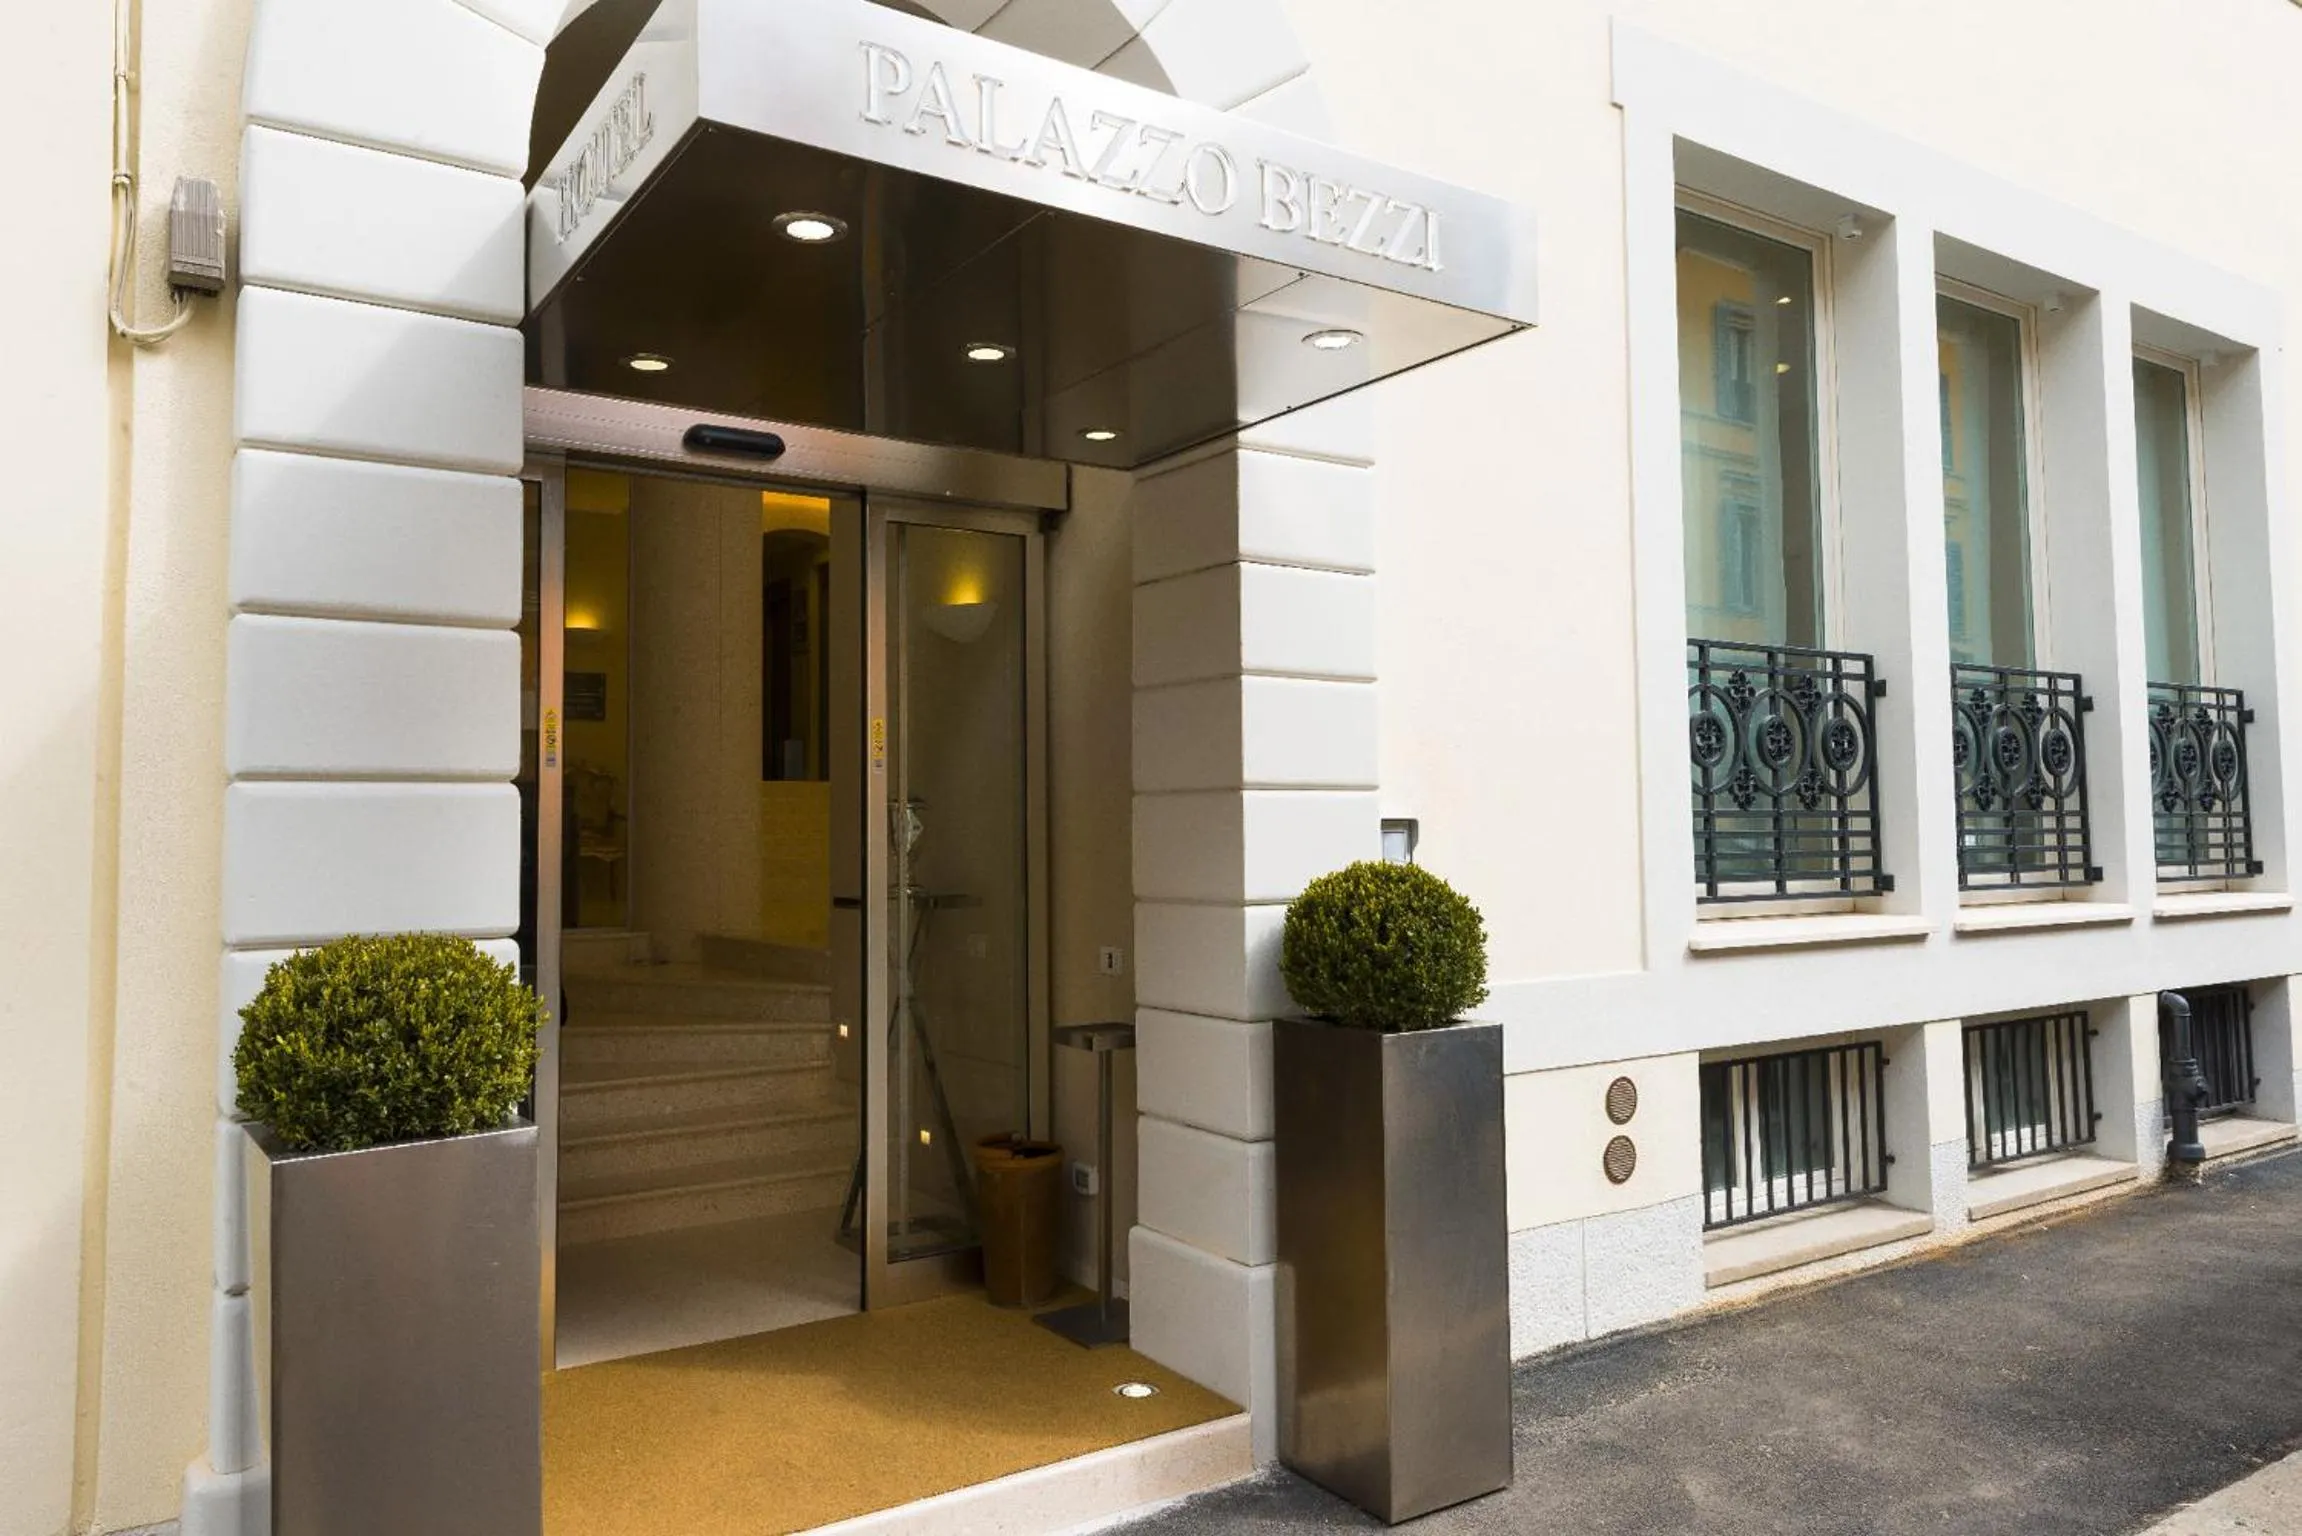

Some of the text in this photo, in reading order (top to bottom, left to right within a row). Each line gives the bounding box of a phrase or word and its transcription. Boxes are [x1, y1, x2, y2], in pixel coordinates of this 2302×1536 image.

[558, 72, 654, 244] HOTEL
[858, 39, 1445, 272] PALAZZO BEZZI
